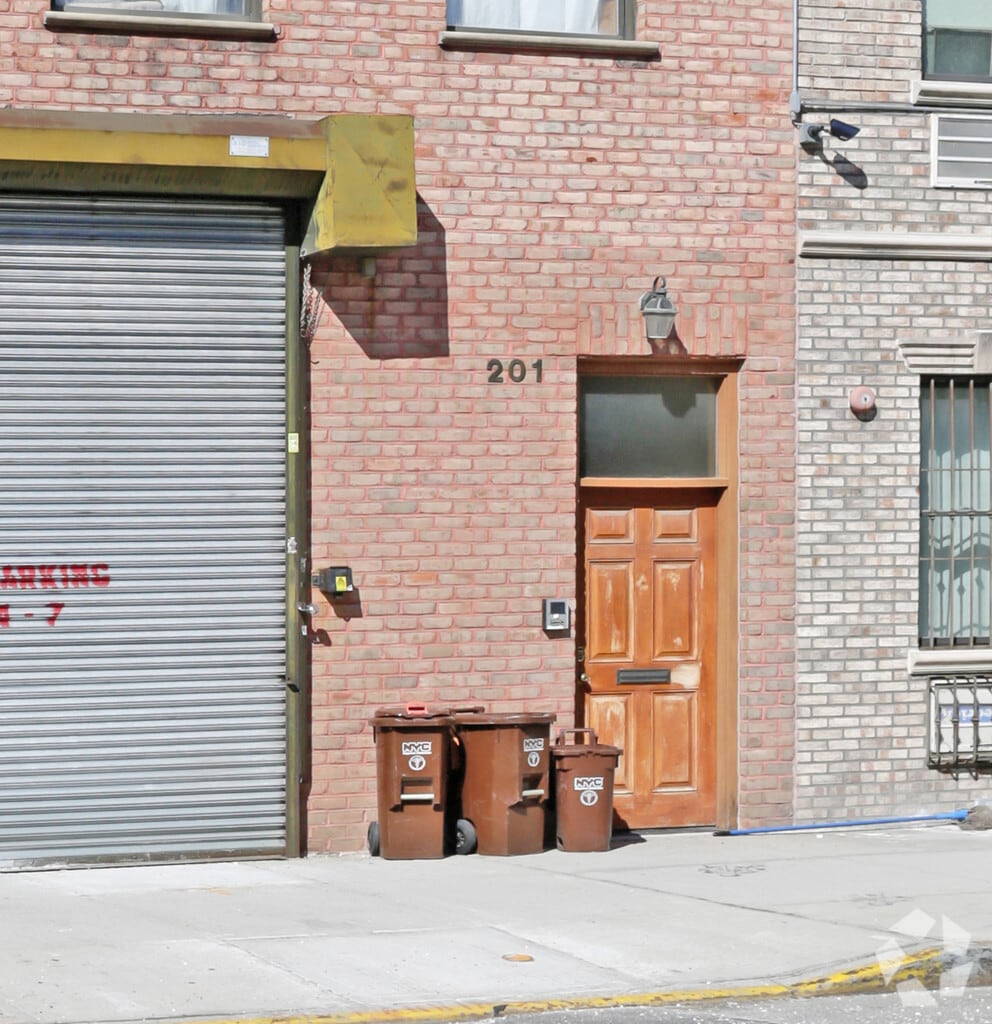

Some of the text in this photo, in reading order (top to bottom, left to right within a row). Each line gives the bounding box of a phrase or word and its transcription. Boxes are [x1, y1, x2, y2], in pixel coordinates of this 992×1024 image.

[487, 358, 543, 383] 201
[402, 741, 432, 753] NYC
[524, 738, 544, 750] NYC
[574, 777, 604, 788] NYC
